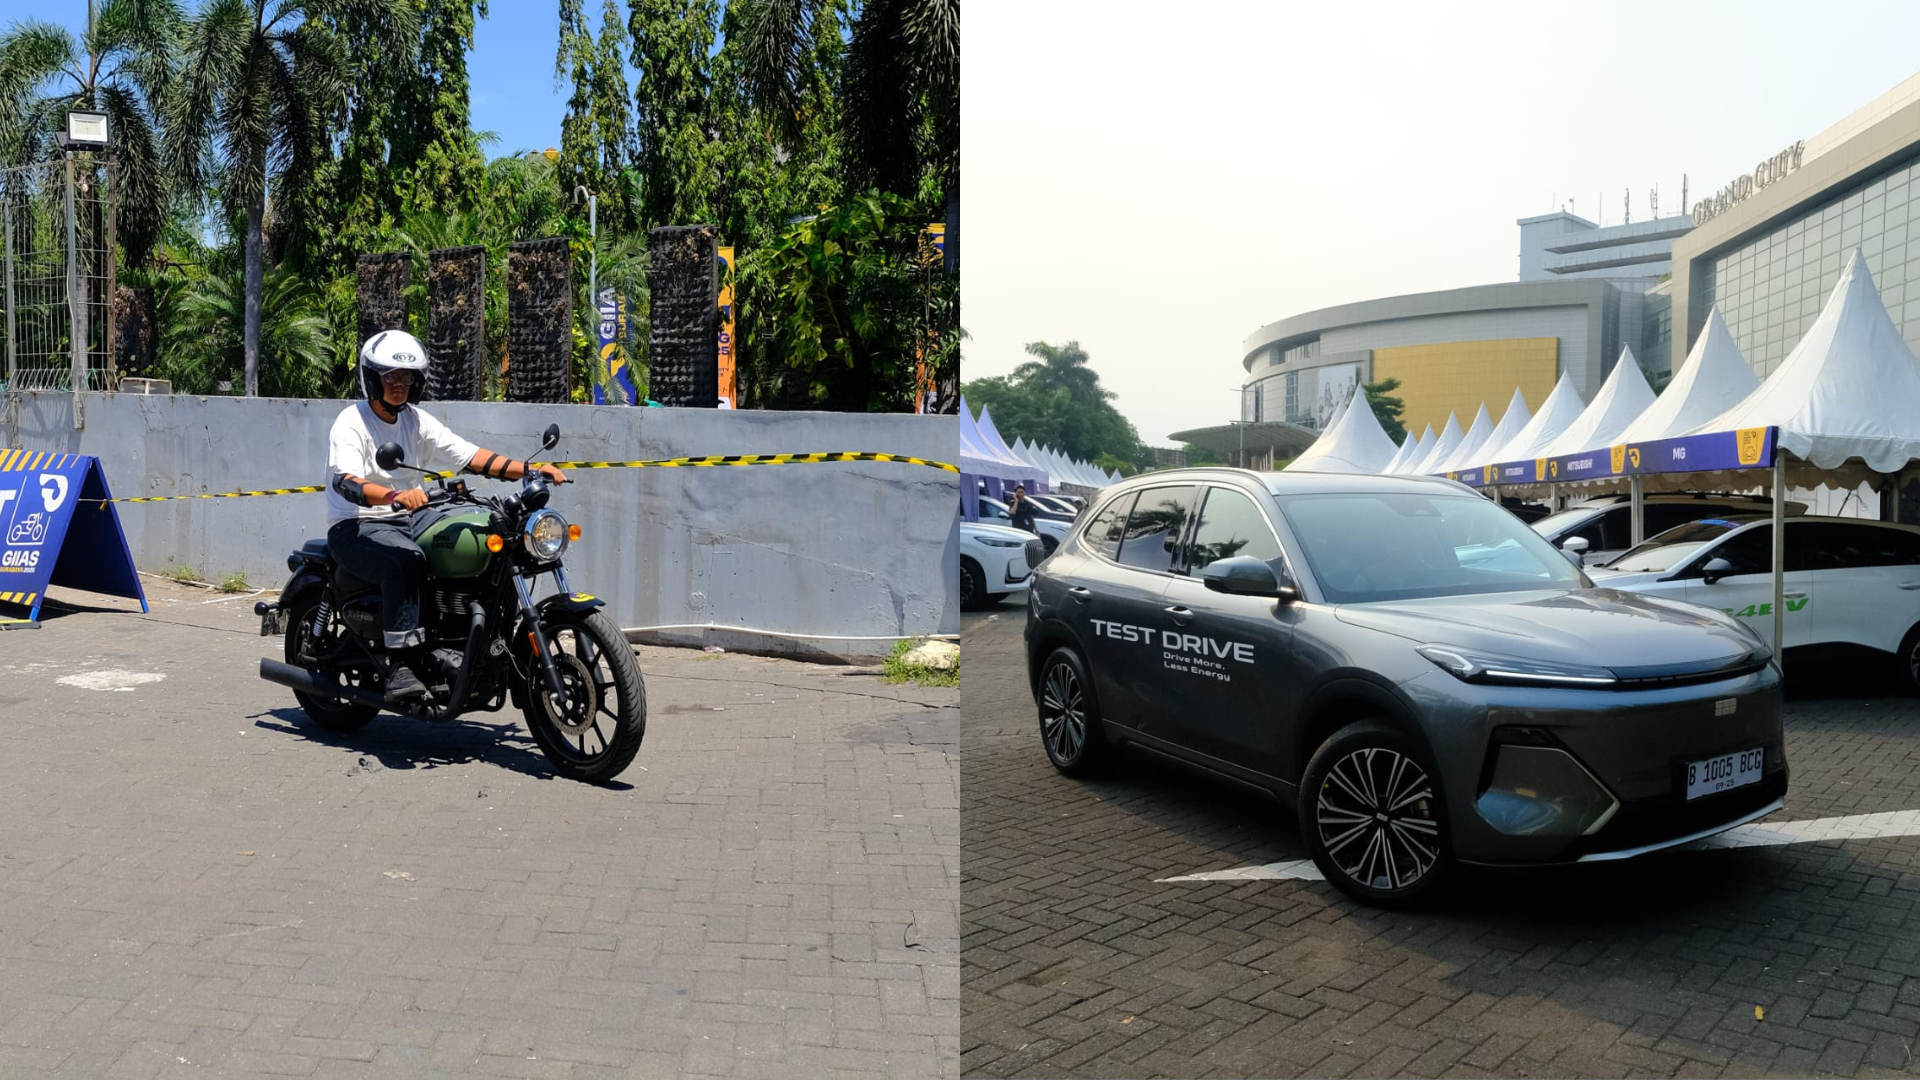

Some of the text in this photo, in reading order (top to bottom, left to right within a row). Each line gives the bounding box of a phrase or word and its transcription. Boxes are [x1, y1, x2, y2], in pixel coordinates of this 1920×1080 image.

[1693, 139, 1805, 226] GRAND CITY
[1673, 447, 1686, 460] MG
[1567, 458, 1593, 471] MITSUBISHI
[2, 550, 40, 567] GIIAS
[1090, 619, 1255, 664] TEST DRIVE
[1163, 651, 1226, 670] Drive More,
[1163, 660, 1231, 682] Less Energy
[1688, 750, 1762, 787] B 1005 BCG
